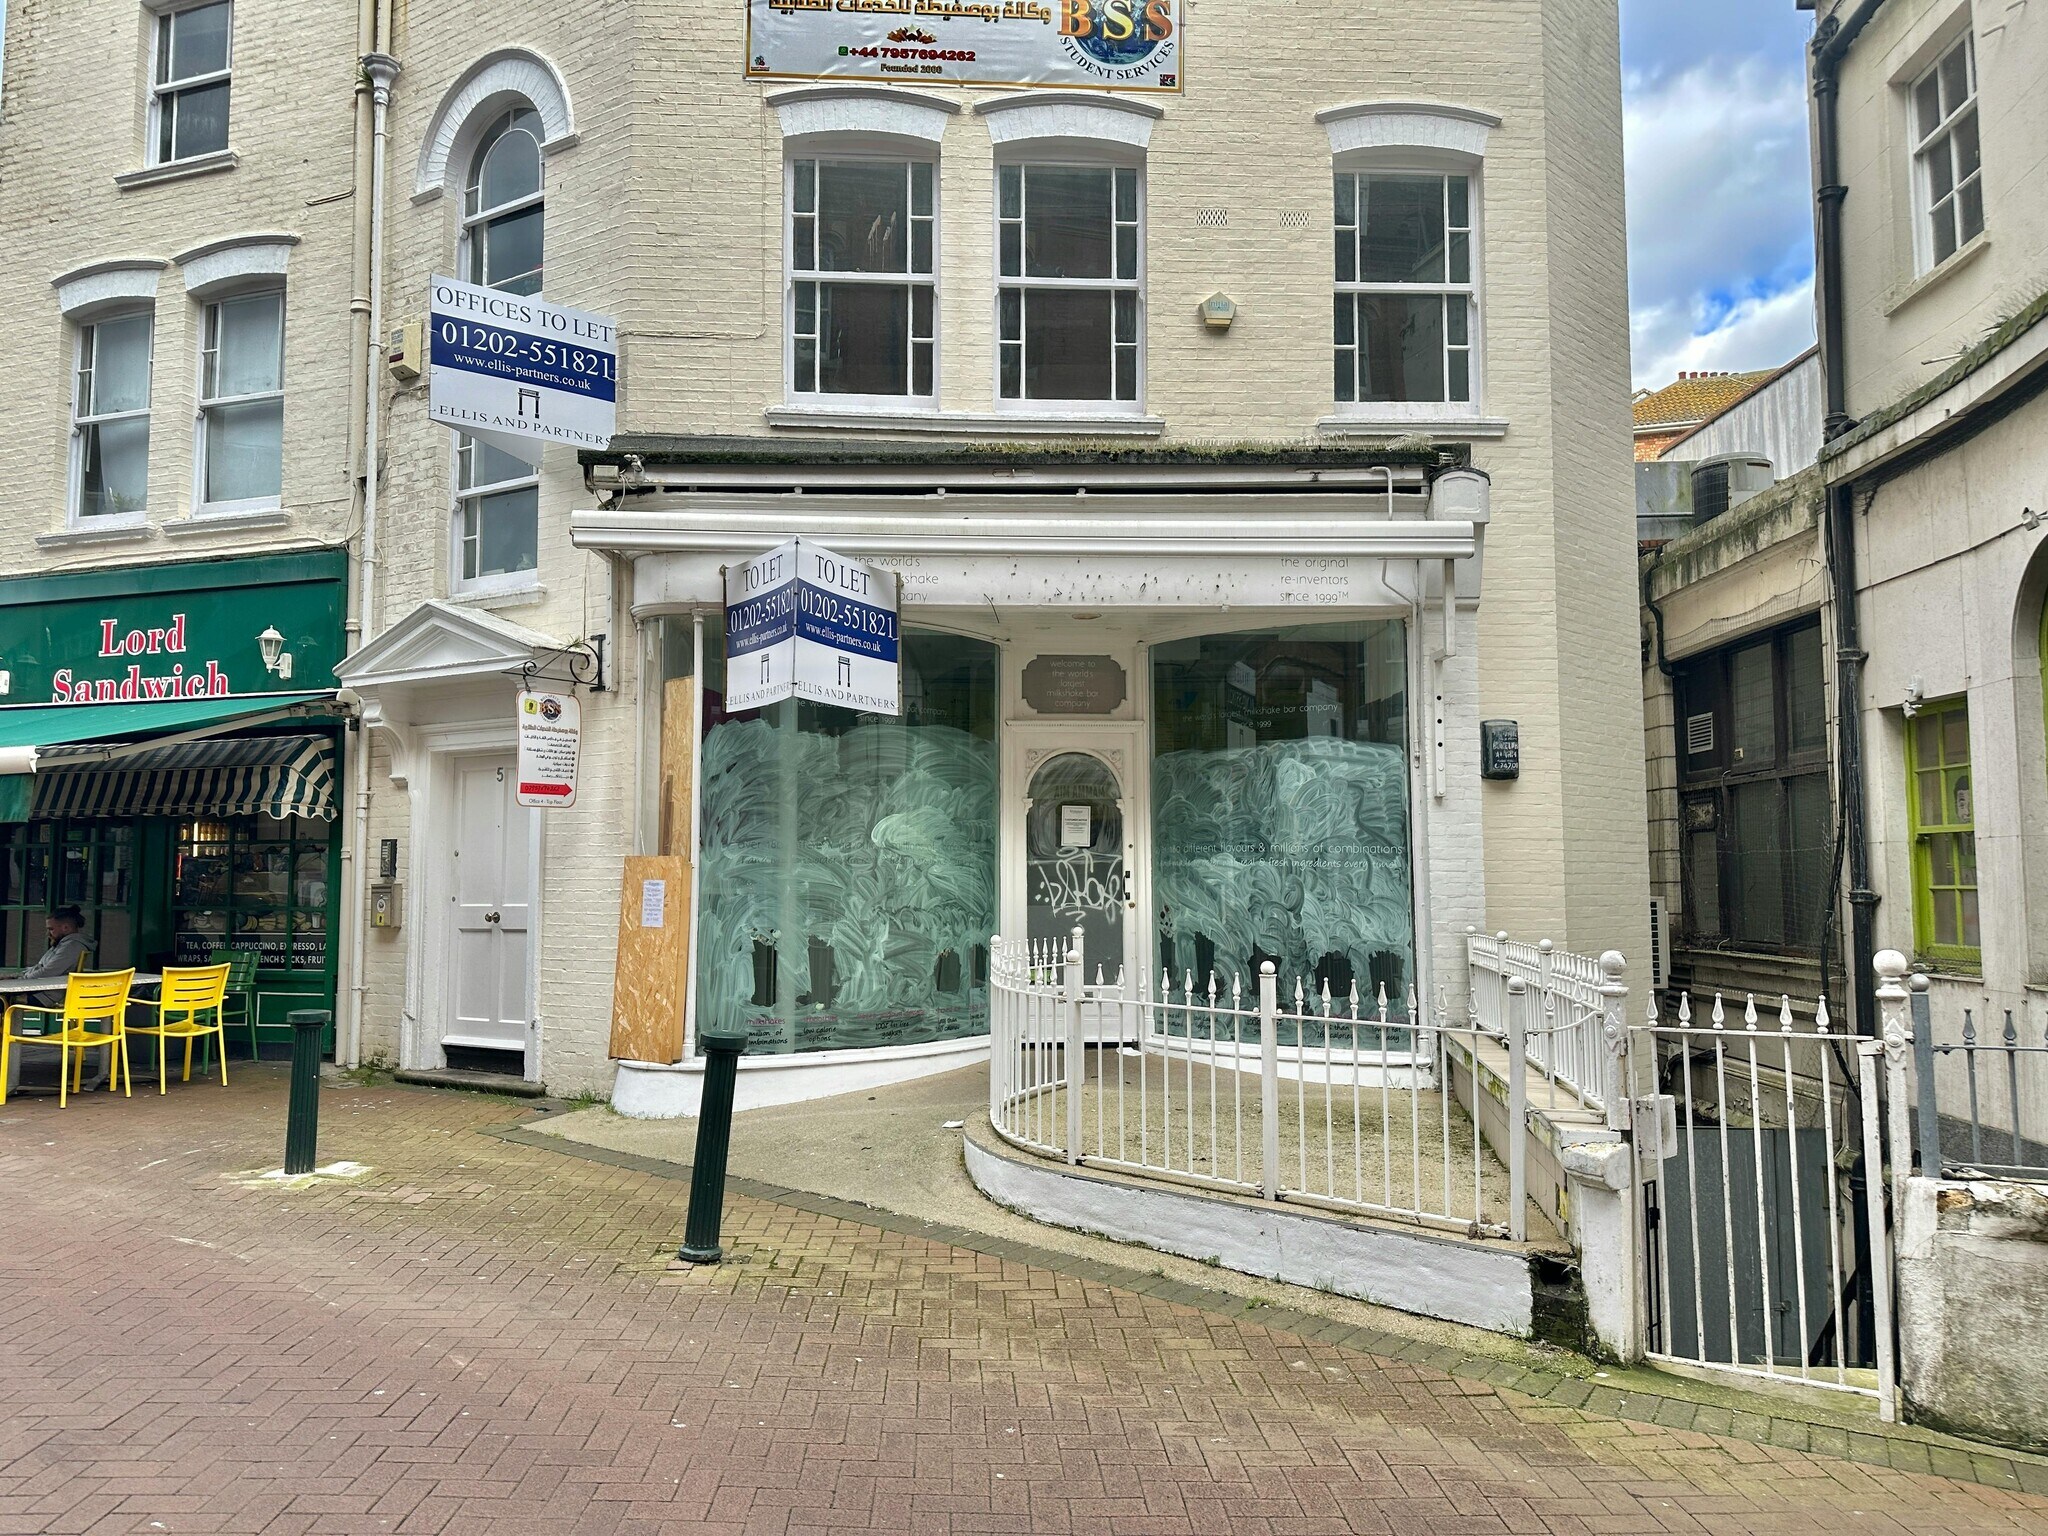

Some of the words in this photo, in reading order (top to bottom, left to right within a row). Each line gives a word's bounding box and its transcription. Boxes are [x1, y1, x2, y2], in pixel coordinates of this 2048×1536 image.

[1057, 0, 1173, 41] BSS
[850, 46, 878, 58] +44
[880, 48, 976, 62] 7957694262
[1060, 36, 1113, 80] STUDENT
[1116, 40, 1175, 80] SERVICES
[880, 63, 919, 73] Founded
[436, 286, 531, 324] OFFICES
[537, 309, 567, 332] TO
[573, 317, 614, 343] LET
[441, 321, 610, 379] 01202-551821
[453, 352, 592, 390] www.ellis-partners.co.uk
[439, 404, 488, 422] ELLIS
[492, 415, 528, 431] AND
[533, 422, 611, 446] PARTNERS
[743, 566, 760, 592] TO
[762, 554, 783, 585] LET
[815, 554, 836, 584] TO
[840, 564, 871, 596] LET
[1281, 558, 1300, 568] the
[1305, 557, 1349, 569] original
[1280, 575, 1349, 586] re-inventors
[730, 586, 794, 633] 01202-551821
[1280, 590, 1309, 602] since
[800, 587, 893, 639] 01202-551821
[99, 613, 186, 658] Lord
[735, 623, 788, 650] www.ellis-partners.co.uk
[805, 621, 881, 653] www.ellis-partners.co.uk
[1049, 659, 1086, 668] welcome
[1087, 660, 1096, 668] to
[52, 660, 229, 704] Sandwich
[797, 680, 822, 696] ELLIS
[824, 685, 844, 701] AND
[846, 689, 896, 709] PARTNERS
[729, 691, 750, 706] ELLIS
[751, 688, 765, 702] AND
[1299, 703, 1338, 713] company
[859, 714, 879, 723] since
[496, 766, 504, 782] 5
[1183, 842, 1217, 853] different
[1220, 842, 1255, 853] flavours
[1258, 842, 1265, 853] &
[1270, 842, 1309, 854] millions
[1312, 843, 1324, 853] of
[1328, 843, 1403, 854] combinations
[1268, 857, 1289, 867] fresh
[1291, 857, 1342, 871] ingredients
[1344, 860, 1368, 870] every
[177, 954, 203, 963] WRAPS,
[186, 941, 201, 951] TEA,
[231, 941, 279, 951] CAPPUCCINO,
